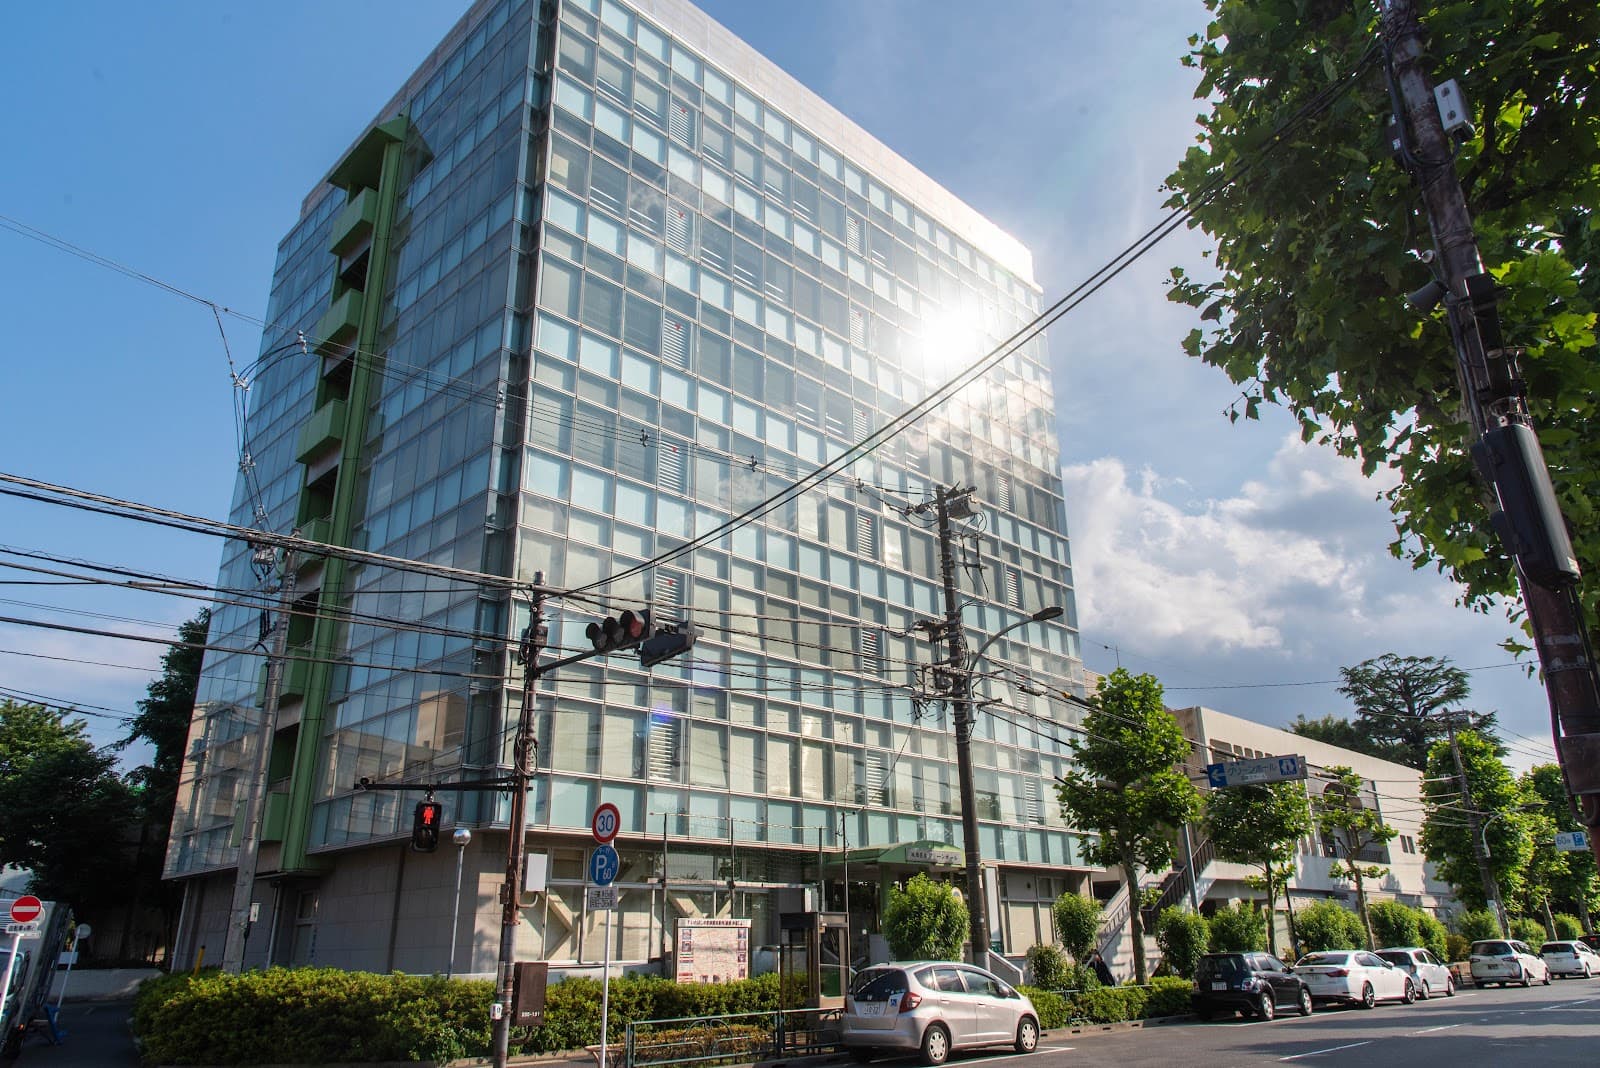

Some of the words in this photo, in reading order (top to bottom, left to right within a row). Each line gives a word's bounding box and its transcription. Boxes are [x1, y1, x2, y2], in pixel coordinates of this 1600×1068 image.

[598, 814, 613, 832] 30
[595, 855, 607, 881] P
[603, 868, 611, 880] 60
